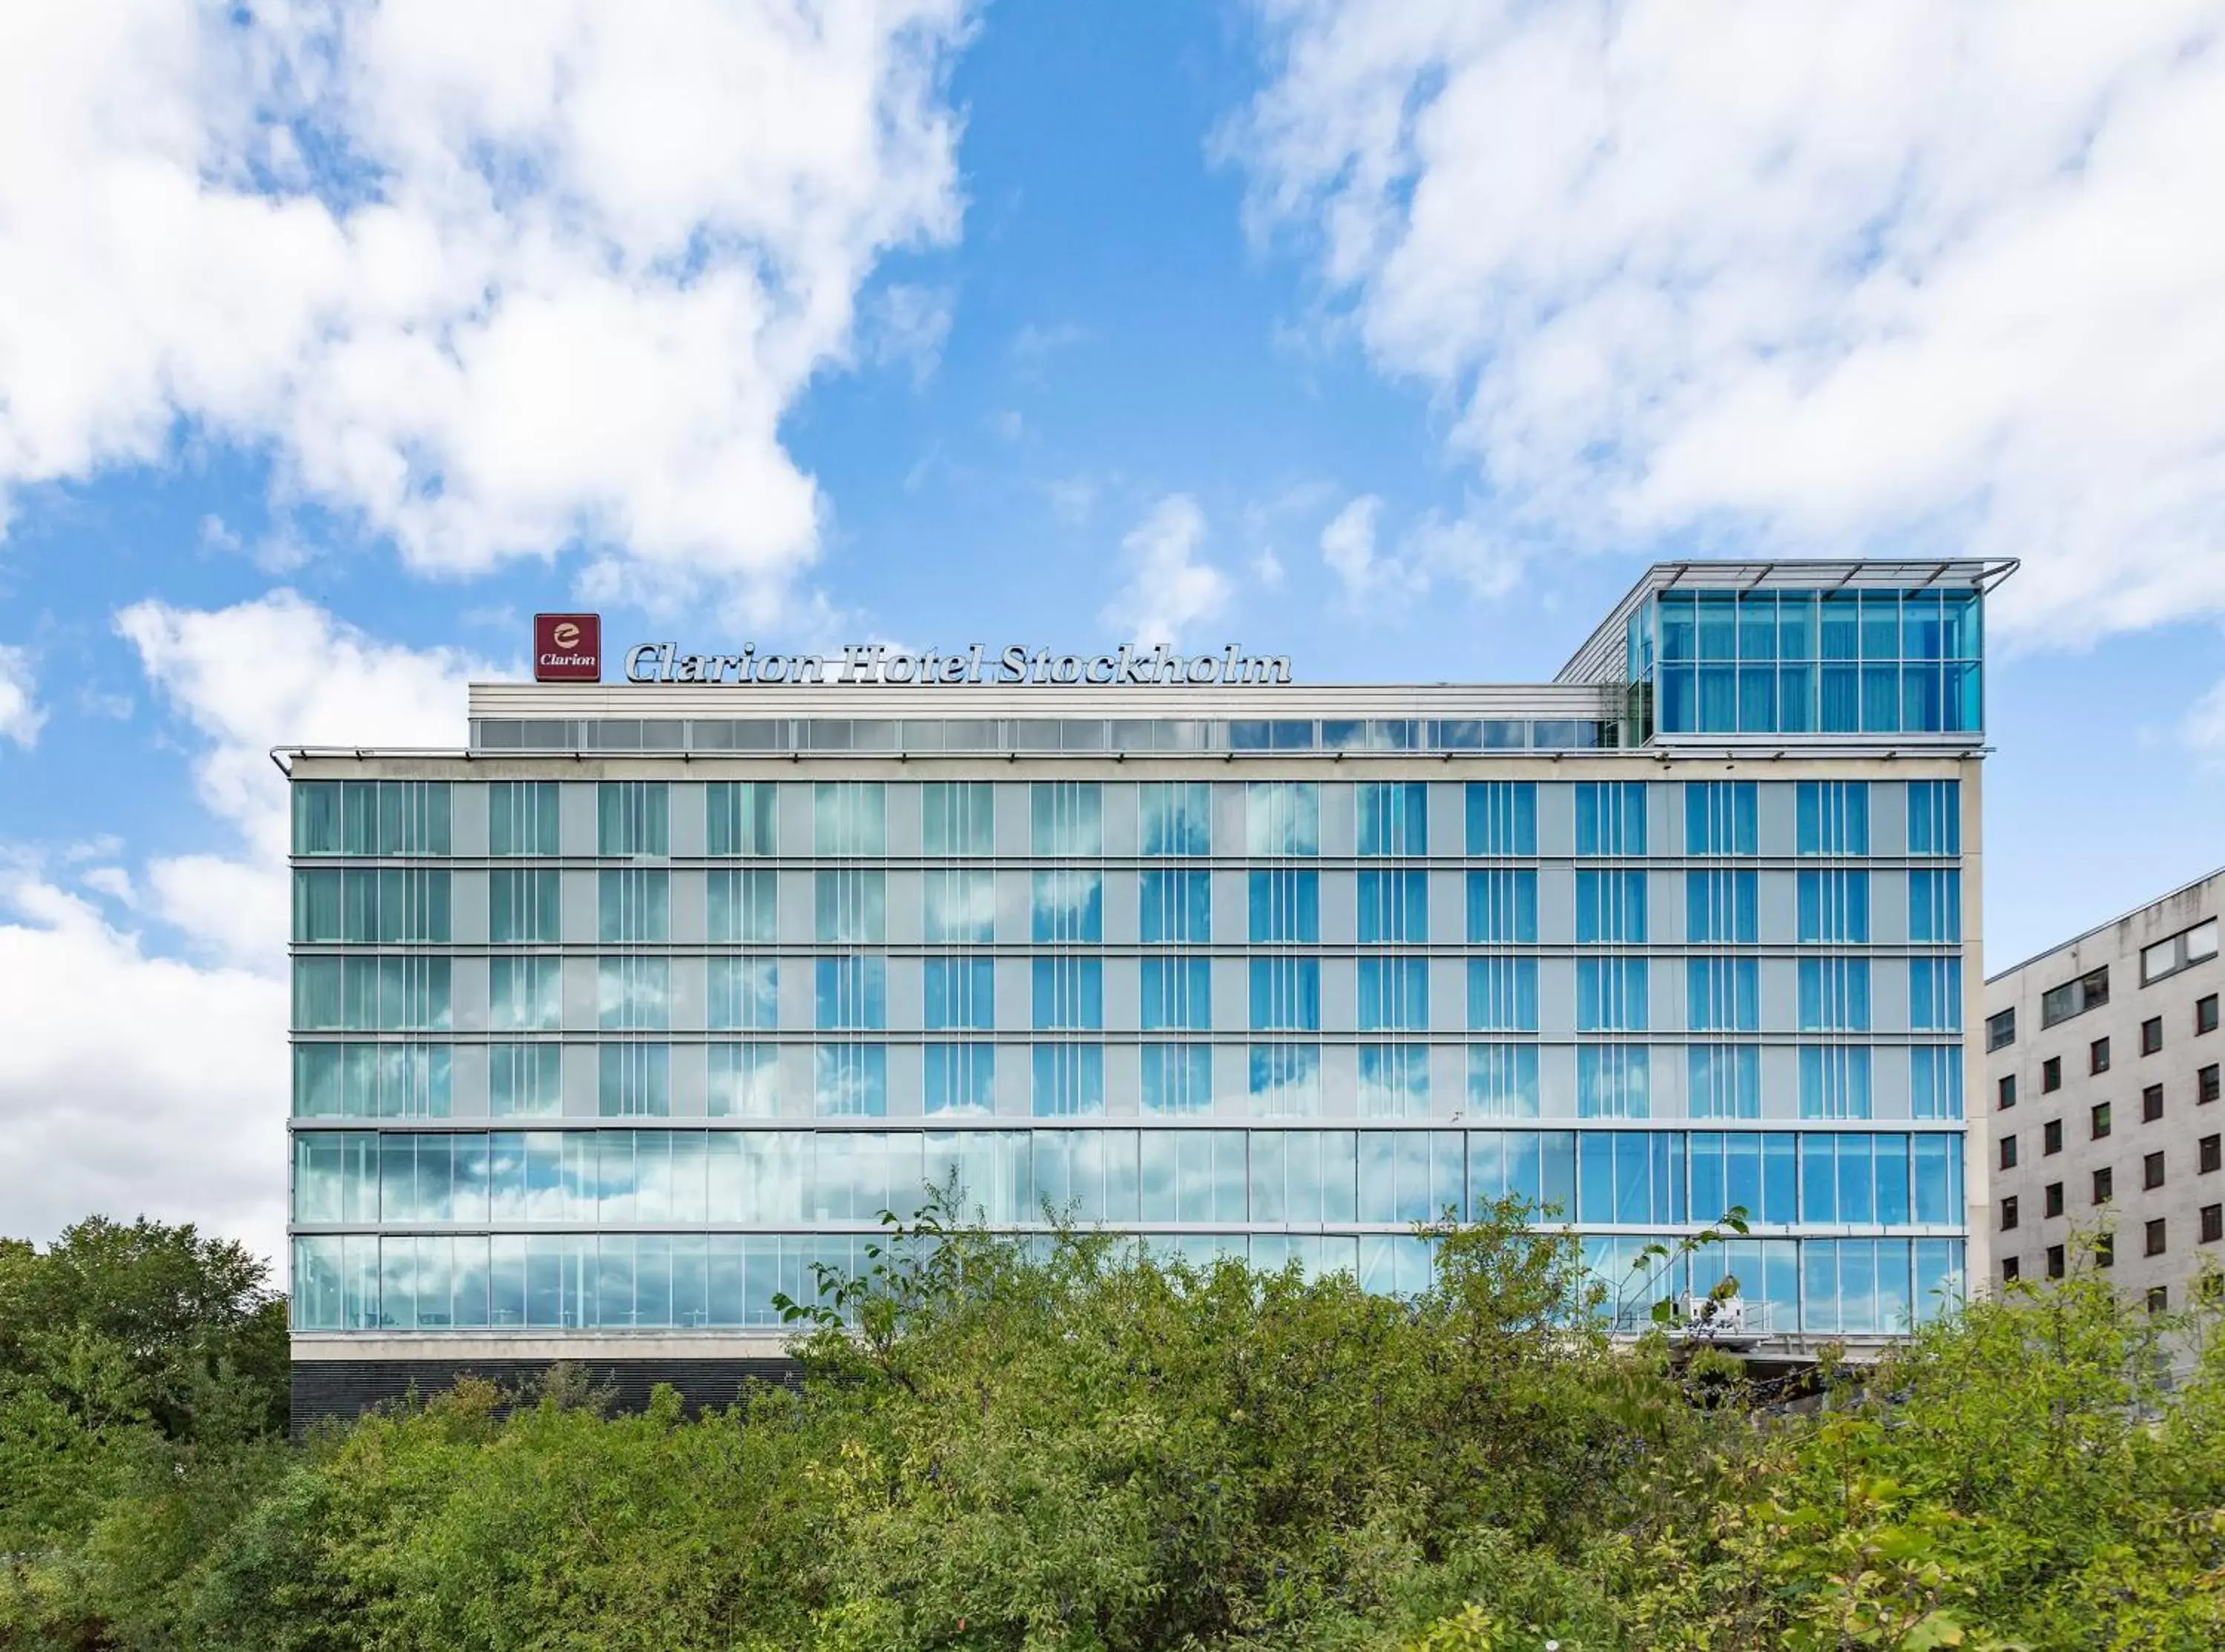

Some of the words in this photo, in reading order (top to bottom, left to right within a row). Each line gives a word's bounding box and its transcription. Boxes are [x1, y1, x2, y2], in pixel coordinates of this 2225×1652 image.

[540, 653, 596, 665] Clarion
[624, 642, 824, 683] Clarion
[837, 644, 985, 683] Hotel
[997, 644, 1293, 683] Stockholm
